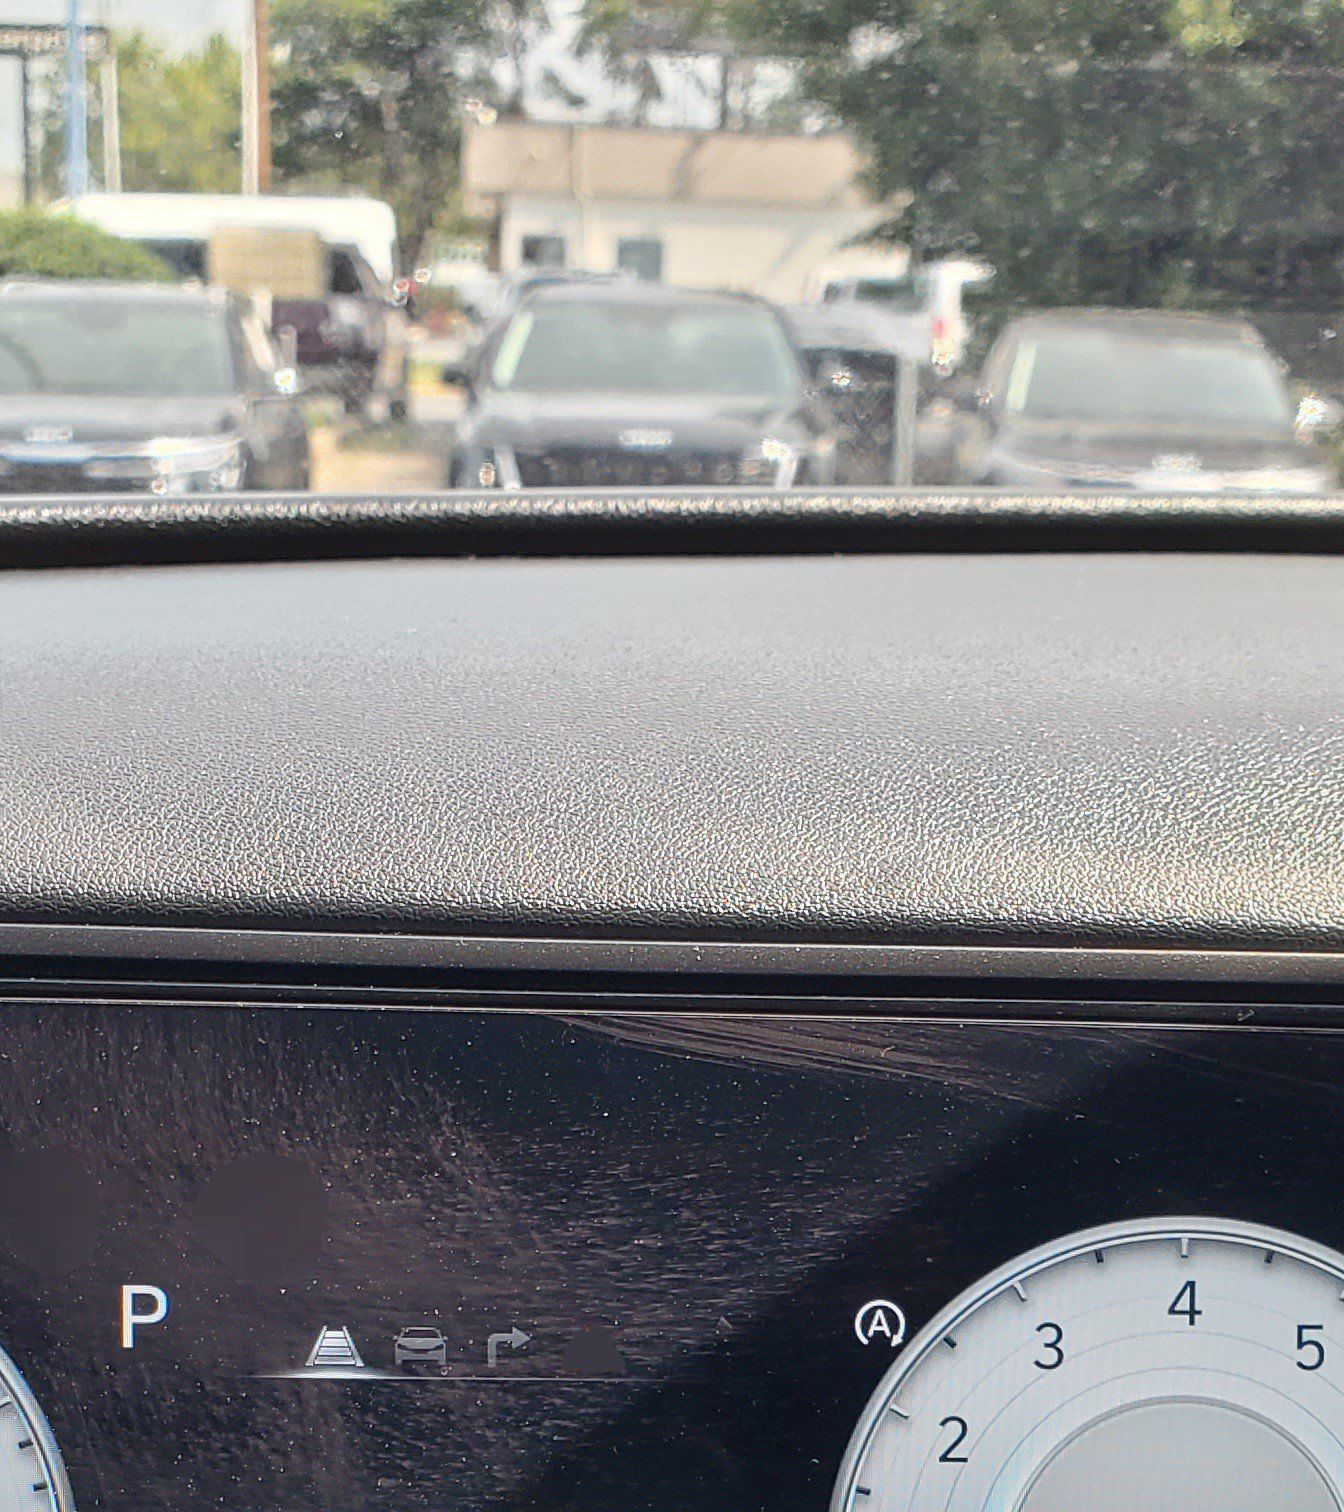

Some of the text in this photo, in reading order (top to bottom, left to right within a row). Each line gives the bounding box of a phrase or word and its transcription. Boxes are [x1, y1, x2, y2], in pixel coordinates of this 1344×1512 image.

[120, 1283, 169, 1348] P
[1167, 1279, 1203, 1326] 4
[1033, 1322, 1065, 1369] 3
[1295, 1324, 1326, 1370] 5
[937, 1416, 970, 1464] 2
